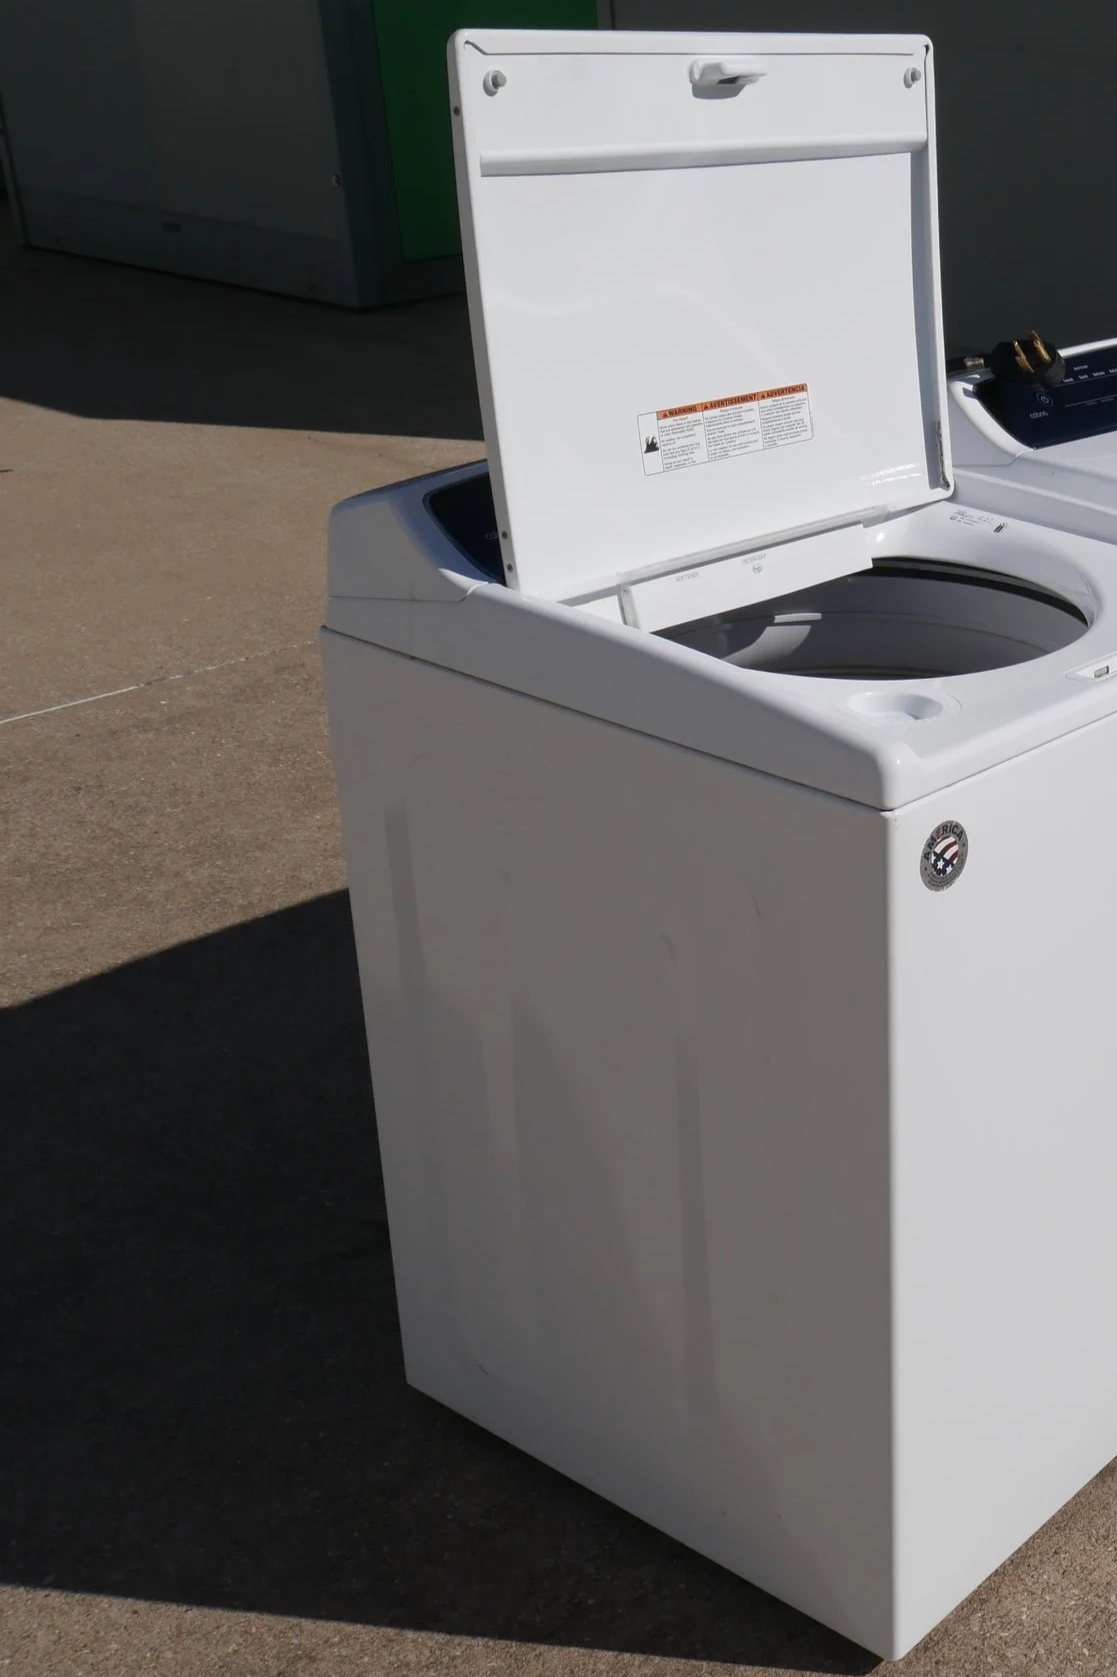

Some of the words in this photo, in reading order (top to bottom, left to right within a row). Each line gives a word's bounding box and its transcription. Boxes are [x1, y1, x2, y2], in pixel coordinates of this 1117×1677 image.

[709, 394, 757, 409] AVERTISSEMENT
[668, 405, 697, 416] WARNING
[923, 824, 964, 861] AMERICA
